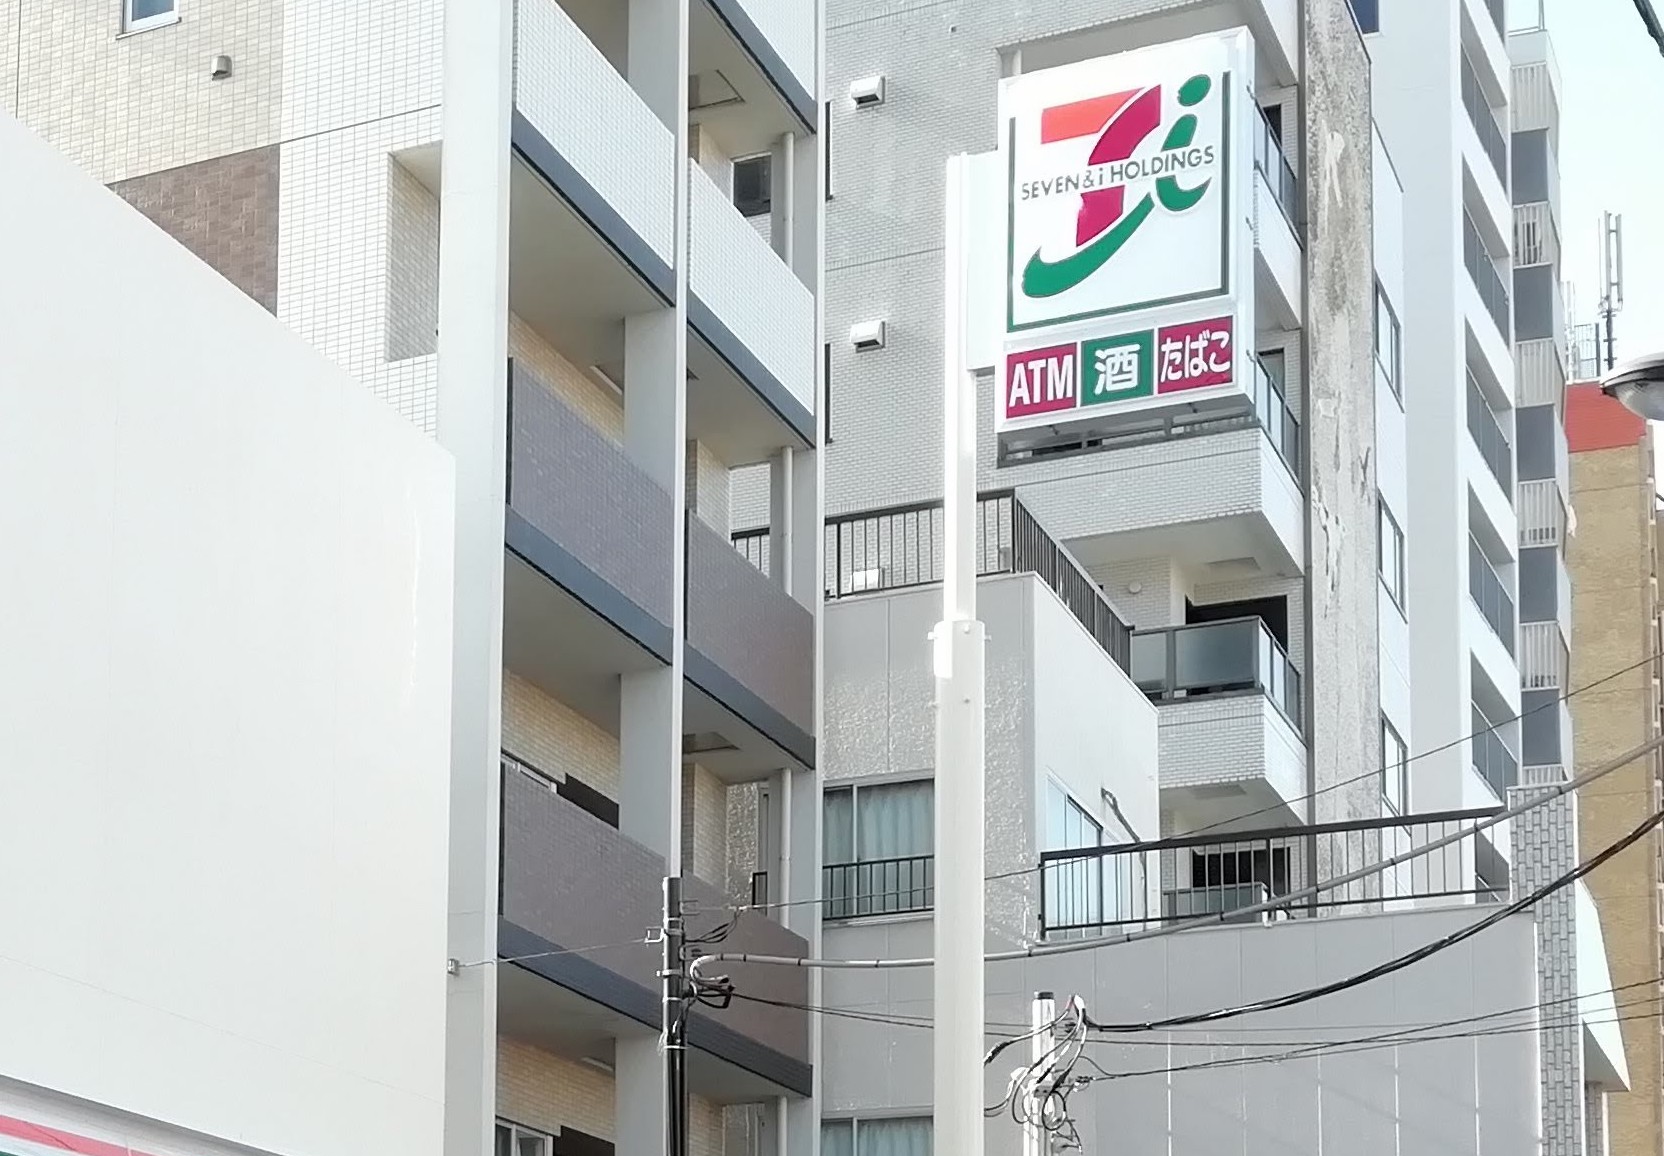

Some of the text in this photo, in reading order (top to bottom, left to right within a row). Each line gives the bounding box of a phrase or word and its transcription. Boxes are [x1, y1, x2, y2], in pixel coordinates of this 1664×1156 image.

[1109, 145, 1215, 184] HOLDINGS
[1008, 355, 1074, 408] ATM
[1093, 343, 1140, 395] 酒
[1160, 330, 1231, 383] たばこ
